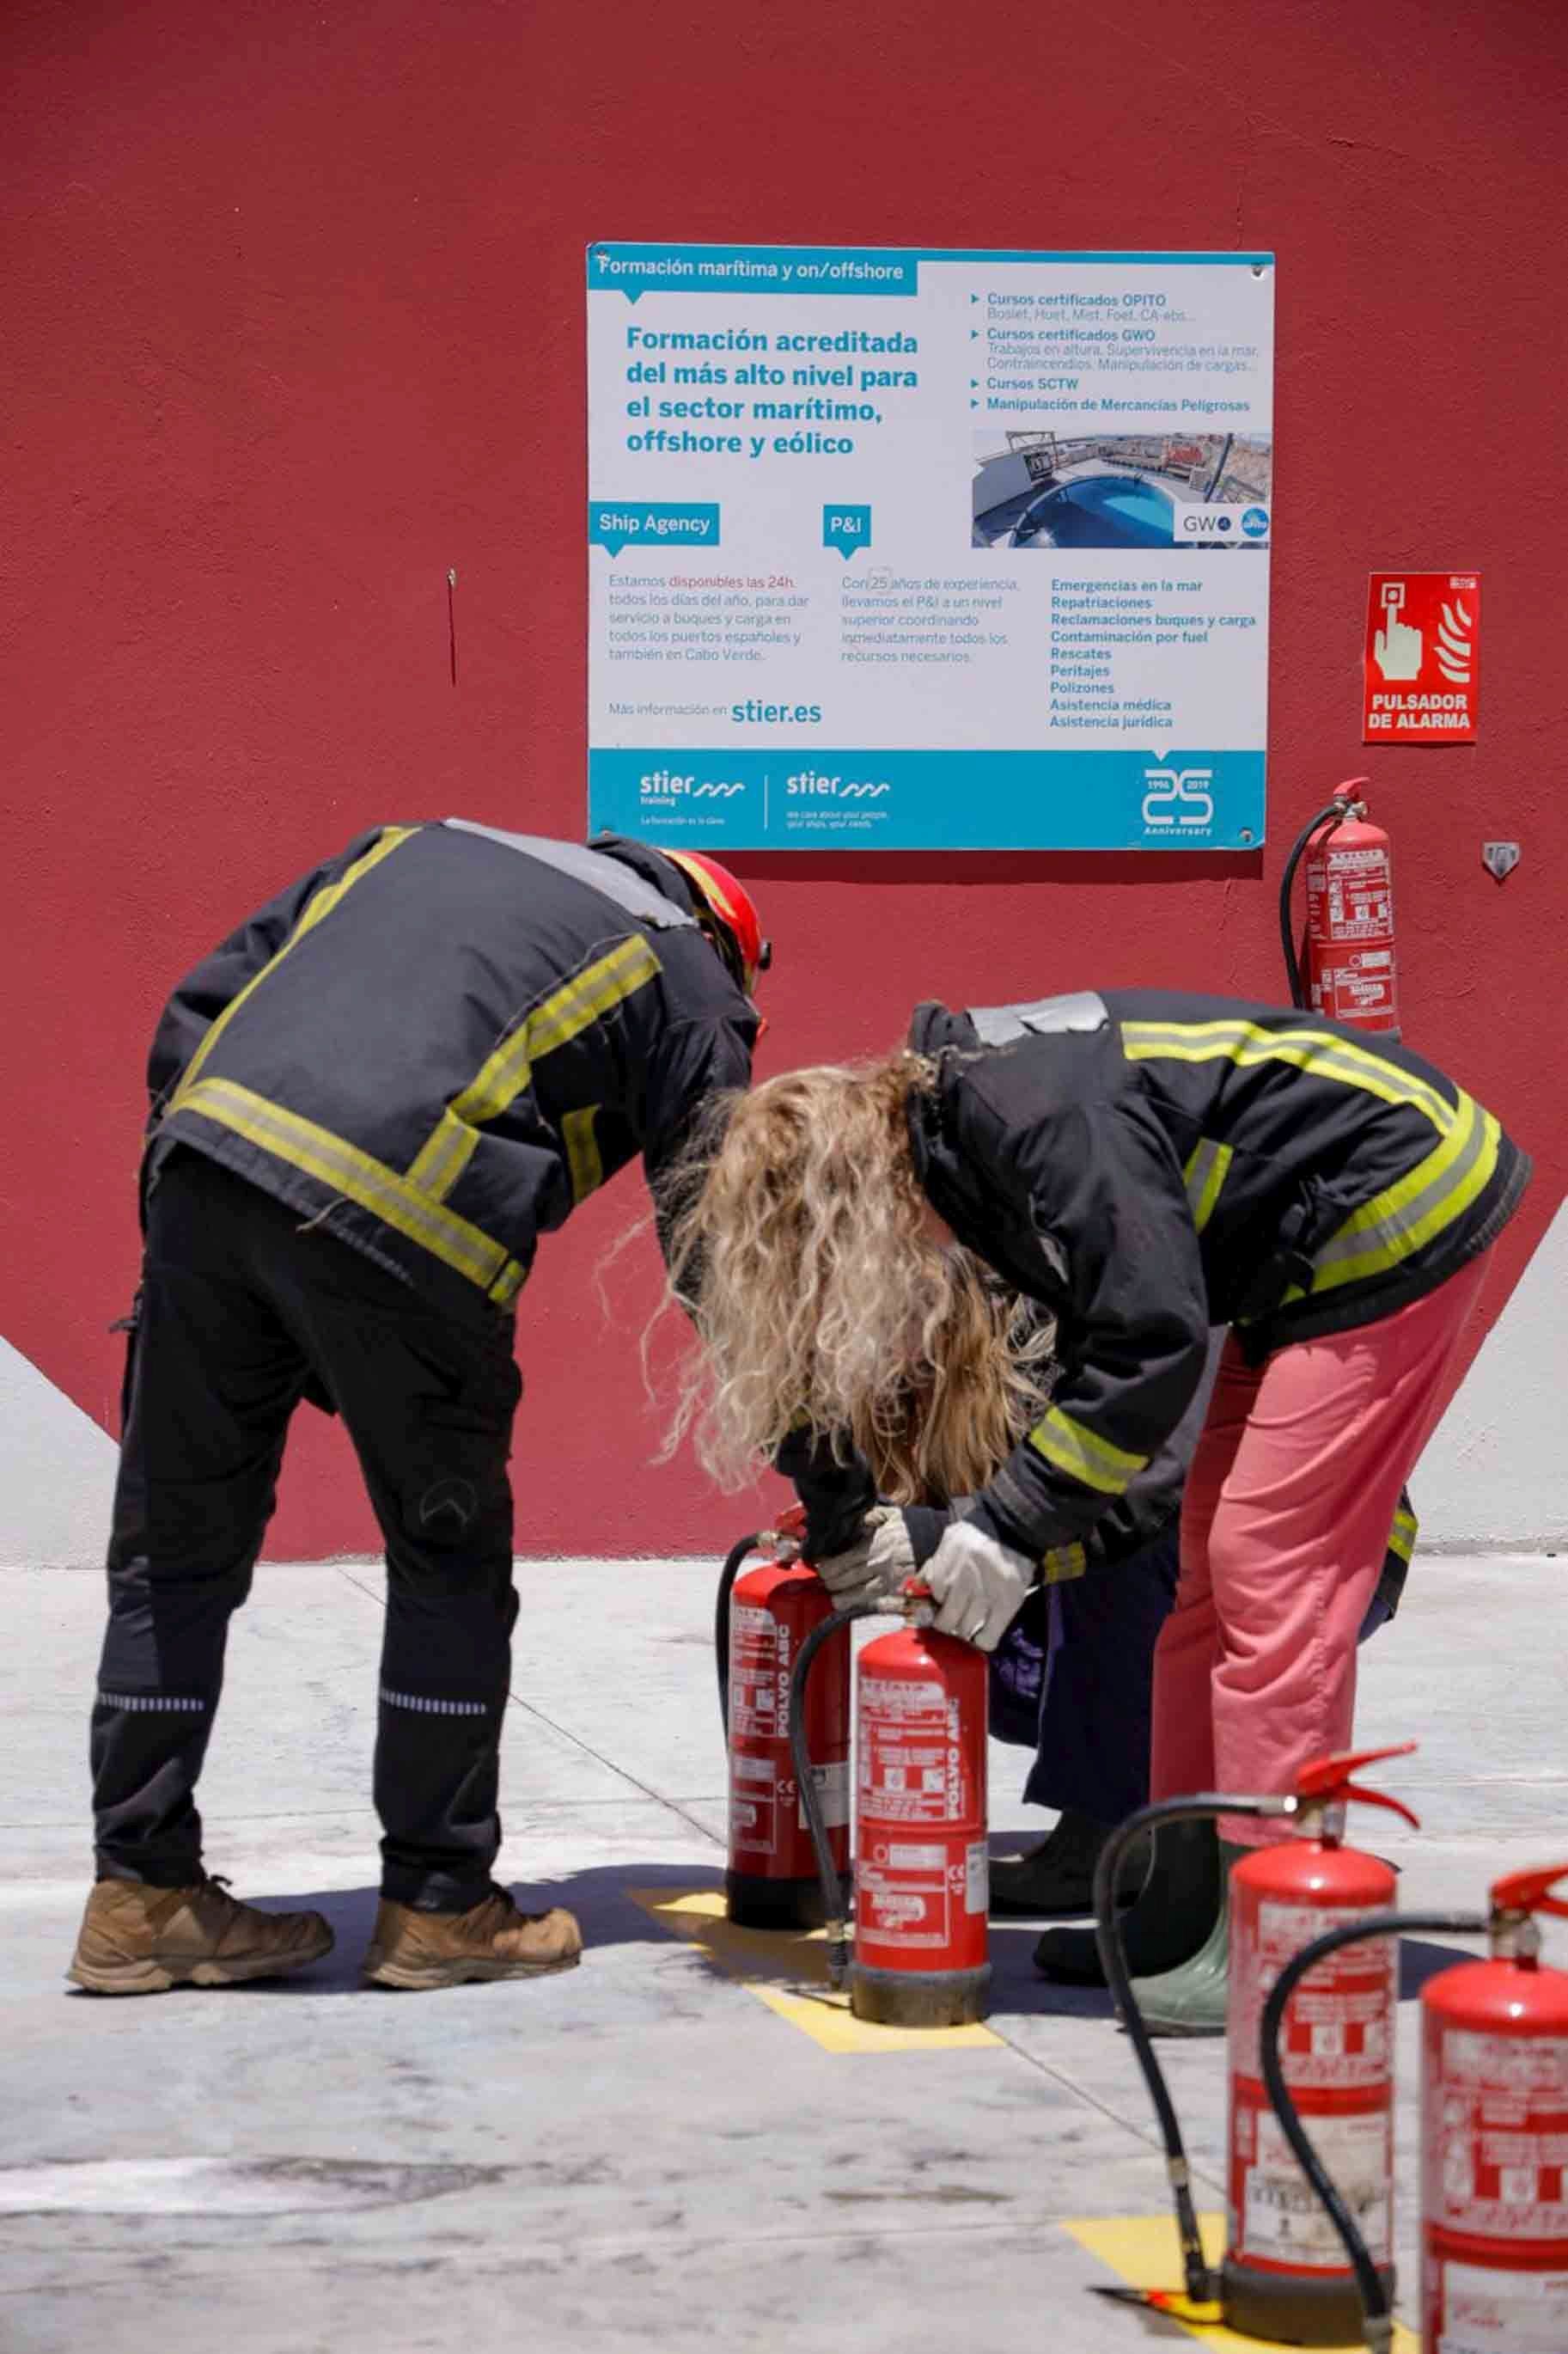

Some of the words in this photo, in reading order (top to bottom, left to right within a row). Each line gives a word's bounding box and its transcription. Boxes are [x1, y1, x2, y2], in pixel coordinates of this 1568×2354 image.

[599, 257, 692, 276] Formación
[699, 259, 777, 278] marítima
[783, 265, 792, 281] y
[796, 260, 904, 279] on/offshore
[987, 293, 1034, 306] Cursos
[1038, 293, 1117, 307] certificados
[1123, 294, 1167, 308] OPITO
[627, 327, 768, 351] Formación
[776, 331, 918, 353] acreditada
[987, 328, 1034, 341] Cursos
[1038, 329, 1118, 342] certificados
[1122, 330, 1156, 342] GWO
[1099, 358, 1184, 373] Manipulación
[1187, 359, 1202, 371] de
[627, 362, 666, 384] del
[674, 362, 728, 385] más
[735, 364, 784, 386] alto
[793, 365, 853, 387] nivel
[861, 370, 918, 391] para
[987, 377, 1034, 390] Cursos
[1038, 378, 1079, 390] SCTW
[627, 396, 650, 418] el
[659, 400, 744, 419] sector
[753, 397, 882, 425] marítimo,
[987, 398, 1077, 413] Manipulación
[1081, 399, 1096, 411] de
[1101, 398, 1178, 413] Mercancías
[1181, 400, 1250, 414] Peligrosas
[627, 431, 741, 453] offshore
[750, 437, 765, 459] y
[774, 431, 854, 454] eólico
[600, 514, 639, 533] Ship
[644, 515, 710, 535] Agency
[831, 517, 862, 533] P&I
[609, 574, 666, 587] Estamos
[669, 576, 743, 590] disponibles
[747, 576, 765, 589] las
[841, 576, 867, 590] Con
[924, 577, 940, 590] de
[1052, 578, 1138, 593] Emergencias
[1141, 582, 1157, 591] en
[1162, 578, 1173, 591] la
[1177, 583, 1203, 591] mar
[609, 595, 646, 606] todos
[650, 595, 668, 606] los
[672, 595, 698, 607] días
[701, 596, 720, 607] del
[755, 598, 784, 610] para
[788, 596, 808, 607] dar
[842, 596, 899, 608] llevamos
[902, 596, 913, 608] el
[917, 596, 939, 608] P&I
[953, 599, 969, 608] un
[973, 596, 1003, 608] nivel
[1052, 596, 1152, 610] Repatriaciones
[609, 612, 659, 624] servicio
[662, 615, 670, 624] a
[674, 613, 721, 627] buques
[725, 616, 733, 628] y
[735, 615, 772, 628] carga
[775, 616, 791, 625] en
[842, 615, 894, 629] superior
[898, 614, 979, 627] coordinando
[1052, 613, 1152, 626] Reclamaciones
[1156, 614, 1204, 628] buques
[1207, 617, 1214, 629] y
[1218, 617, 1256, 628] carga
[609, 630, 646, 642] todos
[650, 630, 668, 642] los
[672, 632, 721, 645] puertos
[725, 631, 790, 645] españoles
[793, 634, 801, 646] y
[950, 633, 985, 645] todos
[1052, 630, 1152, 643] Contaminación
[1156, 634, 1178, 645] por
[1182, 631, 1208, 643] fuel
[609, 647, 662, 660] también
[666, 651, 681, 660] en
[686, 648, 718, 661] Cabo
[841, 651, 898, 663] recursos
[1051, 647, 1112, 659] Rescates
[1051, 664, 1110, 679] Peritajes
[1051, 682, 1114, 694] Polizones
[1050, 699, 1120, 711] Asistencia
[1123, 699, 1172, 711] médica
[1373, 694, 1467, 710] PULSADOR
[609, 703, 634, 715] Más
[637, 703, 710, 716] información
[713, 706, 727, 715] en
[732, 700, 821, 723] stier.es
[1050, 715, 1119, 728] Asistencia
[1122, 715, 1173, 731] jurídica
[1369, 713, 1392, 729] DE
[1397, 713, 1470, 729] ALARMA
[640, 770, 694, 793] stier
[787, 770, 841, 794] stier
[1144, 826, 1211, 835] Anniversary
[777, 1671, 790, 1739] POLVO
[948, 1746, 961, 1821] POLVO
